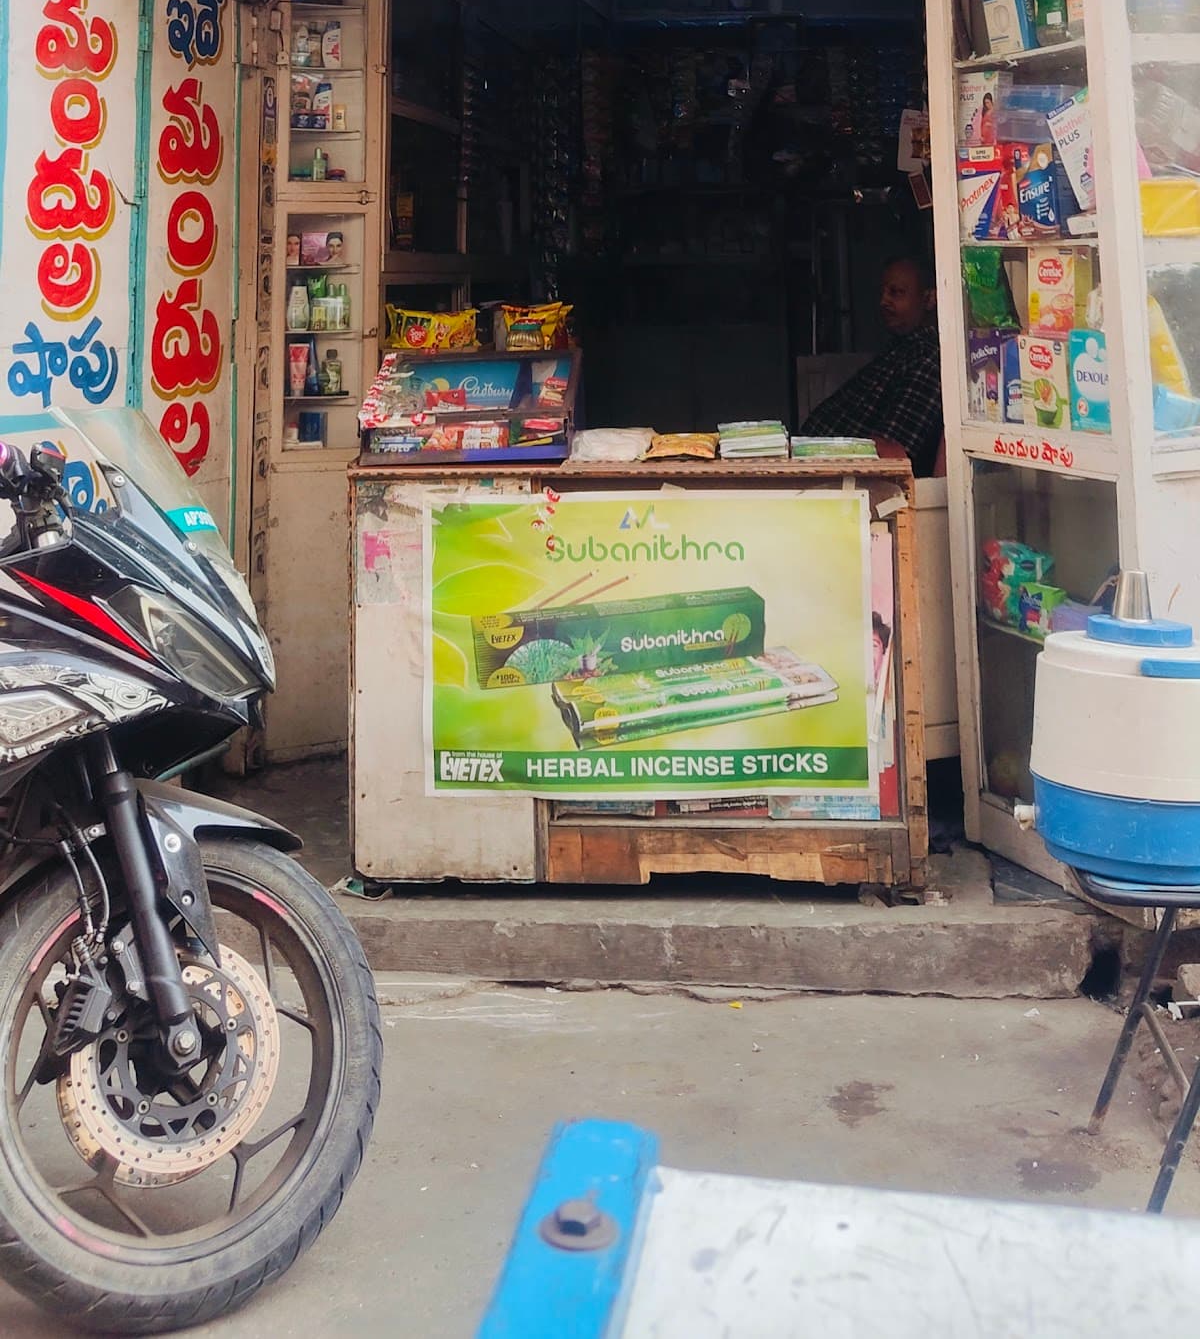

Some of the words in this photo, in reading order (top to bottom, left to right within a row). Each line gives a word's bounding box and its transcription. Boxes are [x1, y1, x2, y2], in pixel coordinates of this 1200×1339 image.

[1057, 128, 1081, 149] PLUS
[960, 175, 995, 212] Protinex
[1019, 180, 1050, 204] Ensure
[457, 375, 514, 400] Cadbury
[546, 533, 745, 562] Subanithra
[620, 628, 725, 653] Subanithra
[526, 757, 625, 778] HERBAL
[630, 755, 736, 777] INCENSE
[741, 752, 829, 774] STICKS
